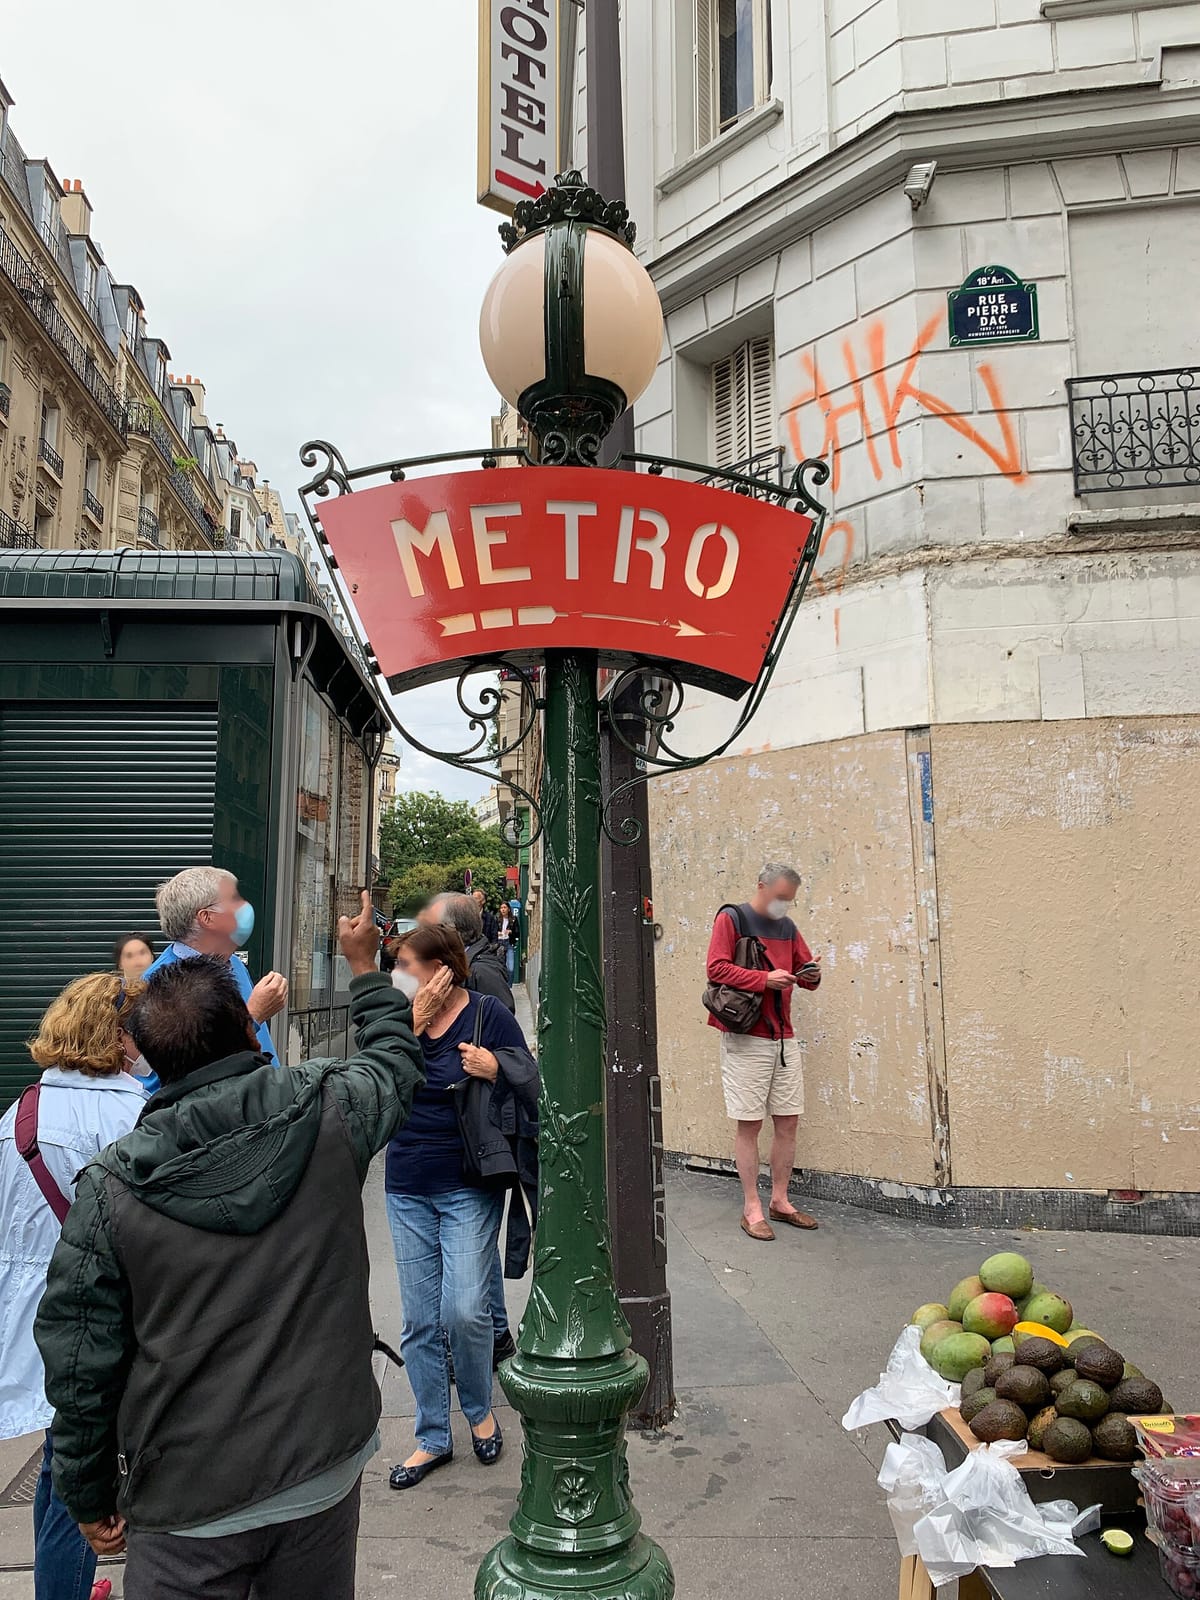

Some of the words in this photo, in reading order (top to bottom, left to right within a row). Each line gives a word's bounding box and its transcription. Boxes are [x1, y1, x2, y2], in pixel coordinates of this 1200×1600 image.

[500, 0, 549, 175] OTEL
[979, 294, 1005, 305] RUE
[967, 303, 1018, 317] PIERRE
[980, 315, 1006, 326] DAC
[391, 502, 740, 599] METRO
